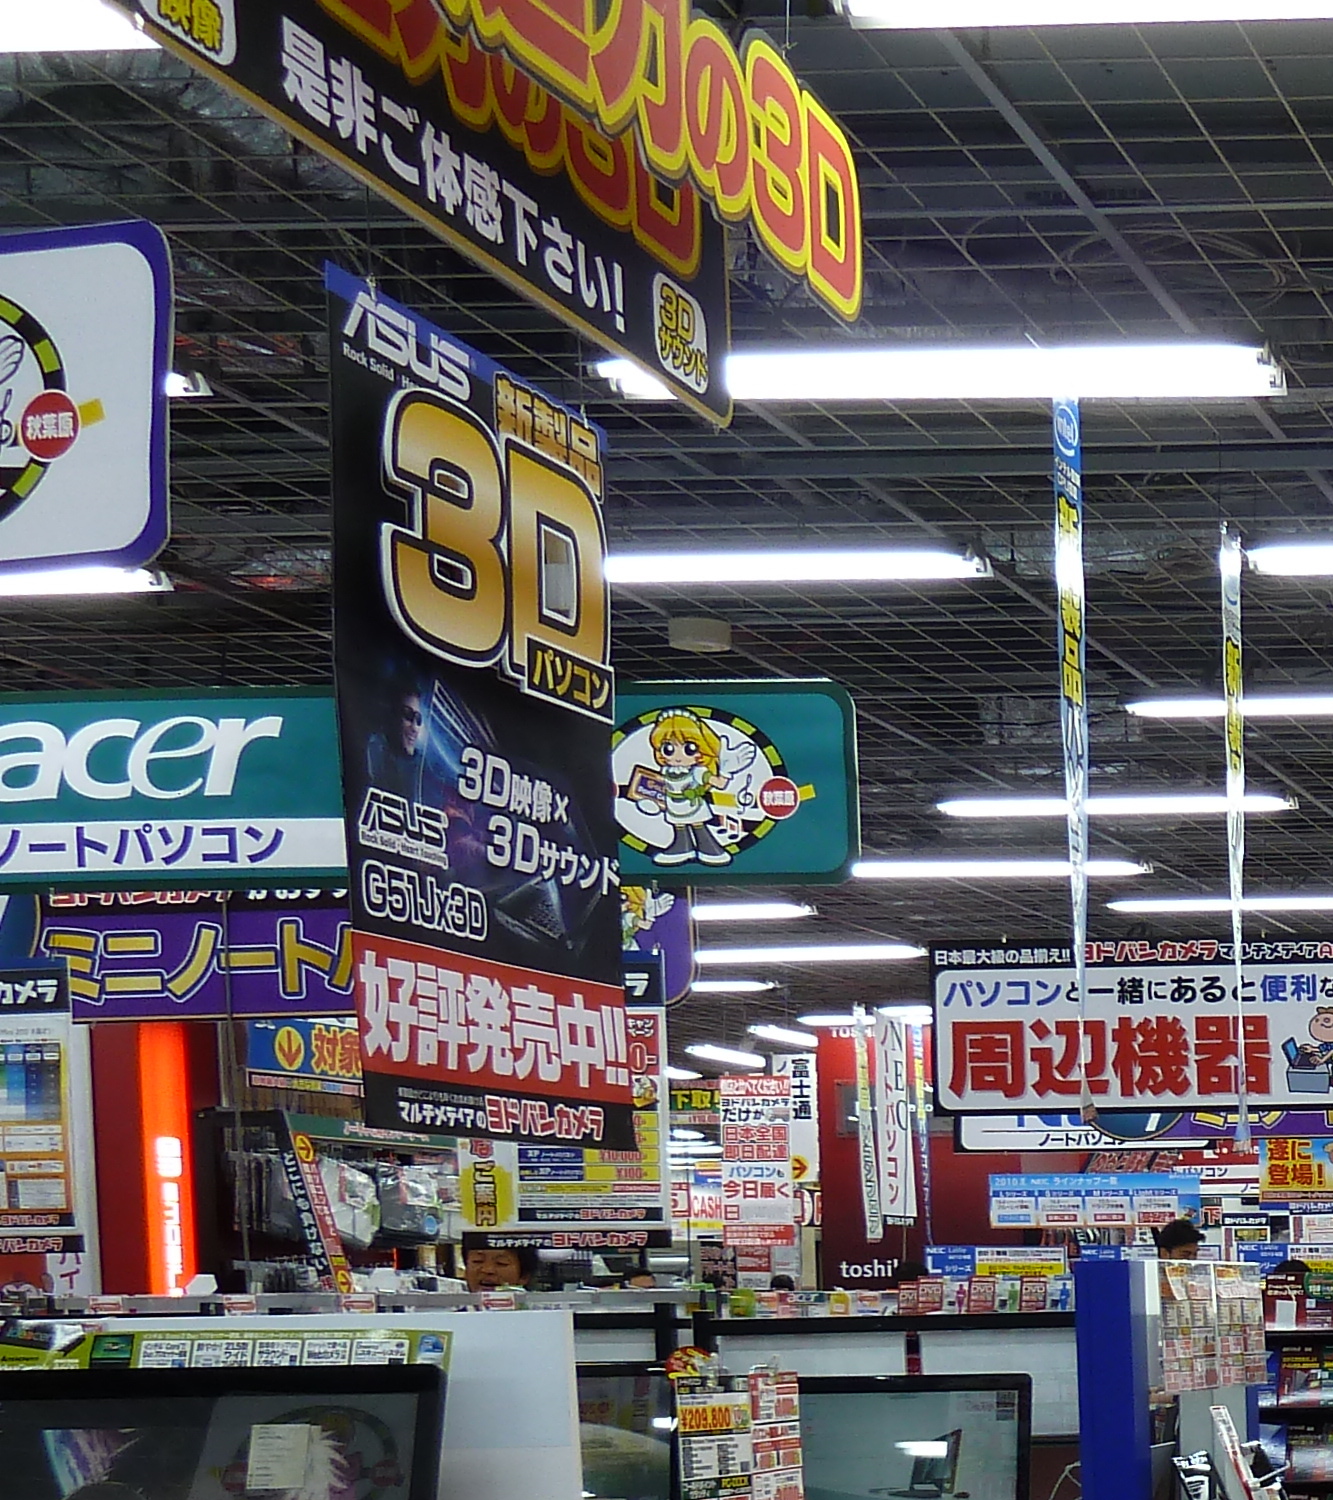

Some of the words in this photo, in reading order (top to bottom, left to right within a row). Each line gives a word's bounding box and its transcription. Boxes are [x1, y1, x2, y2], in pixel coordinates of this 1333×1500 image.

[281, 15, 625, 334] 是非ご体感下さい!
[343, 290, 471, 401] ASUS
[377, 387, 609, 670] 3D
[532, 650, 610, 708] パソコン
[0, 714, 281, 801] acer
[359, 788, 449, 851] ASUS
[486, 814, 622, 895] 3Dサウンド
[362, 860, 488, 942] G51Jx3D
[359, 949, 629, 1088] 好評発売中!!
[947, 1014, 1272, 1100] 周辺機器
[721, 1108, 766, 1123] だけが
[791, 1058, 812, 1121] 富士通
[880, 1021, 900, 1205] ノートパソコン
[722, 1180, 790, 1199] 今日届く
[1267, 1163, 1326, 1187] 登場!
[681, 1406, 731, 1429] ¥209,800
